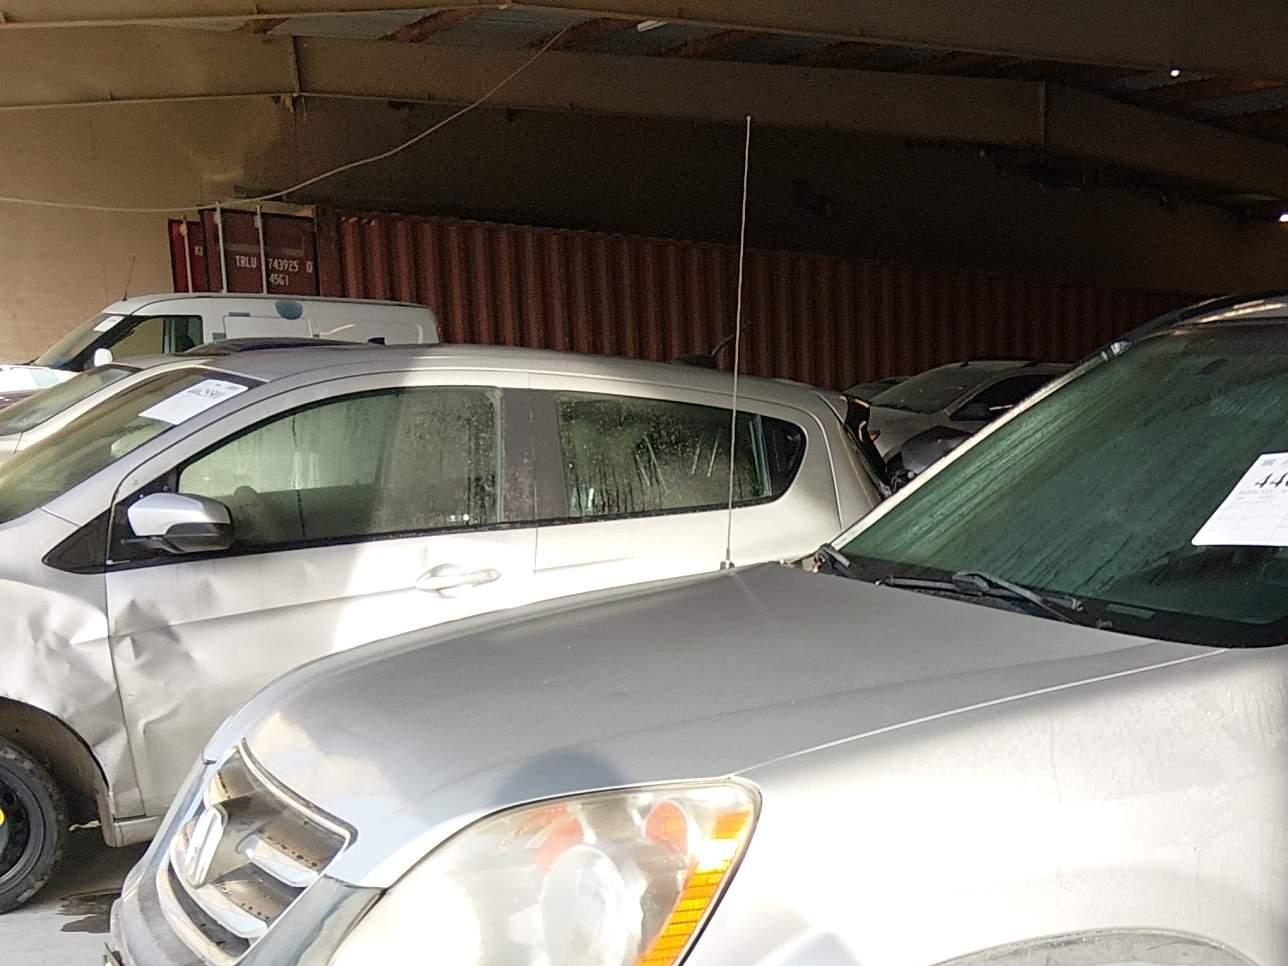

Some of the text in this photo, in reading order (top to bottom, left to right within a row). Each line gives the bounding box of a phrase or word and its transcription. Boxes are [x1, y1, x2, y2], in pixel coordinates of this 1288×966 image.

[234, 255, 257, 268] TRLU
[267, 258, 299, 273] 743925
[269, 273, 289, 286] 45G1
